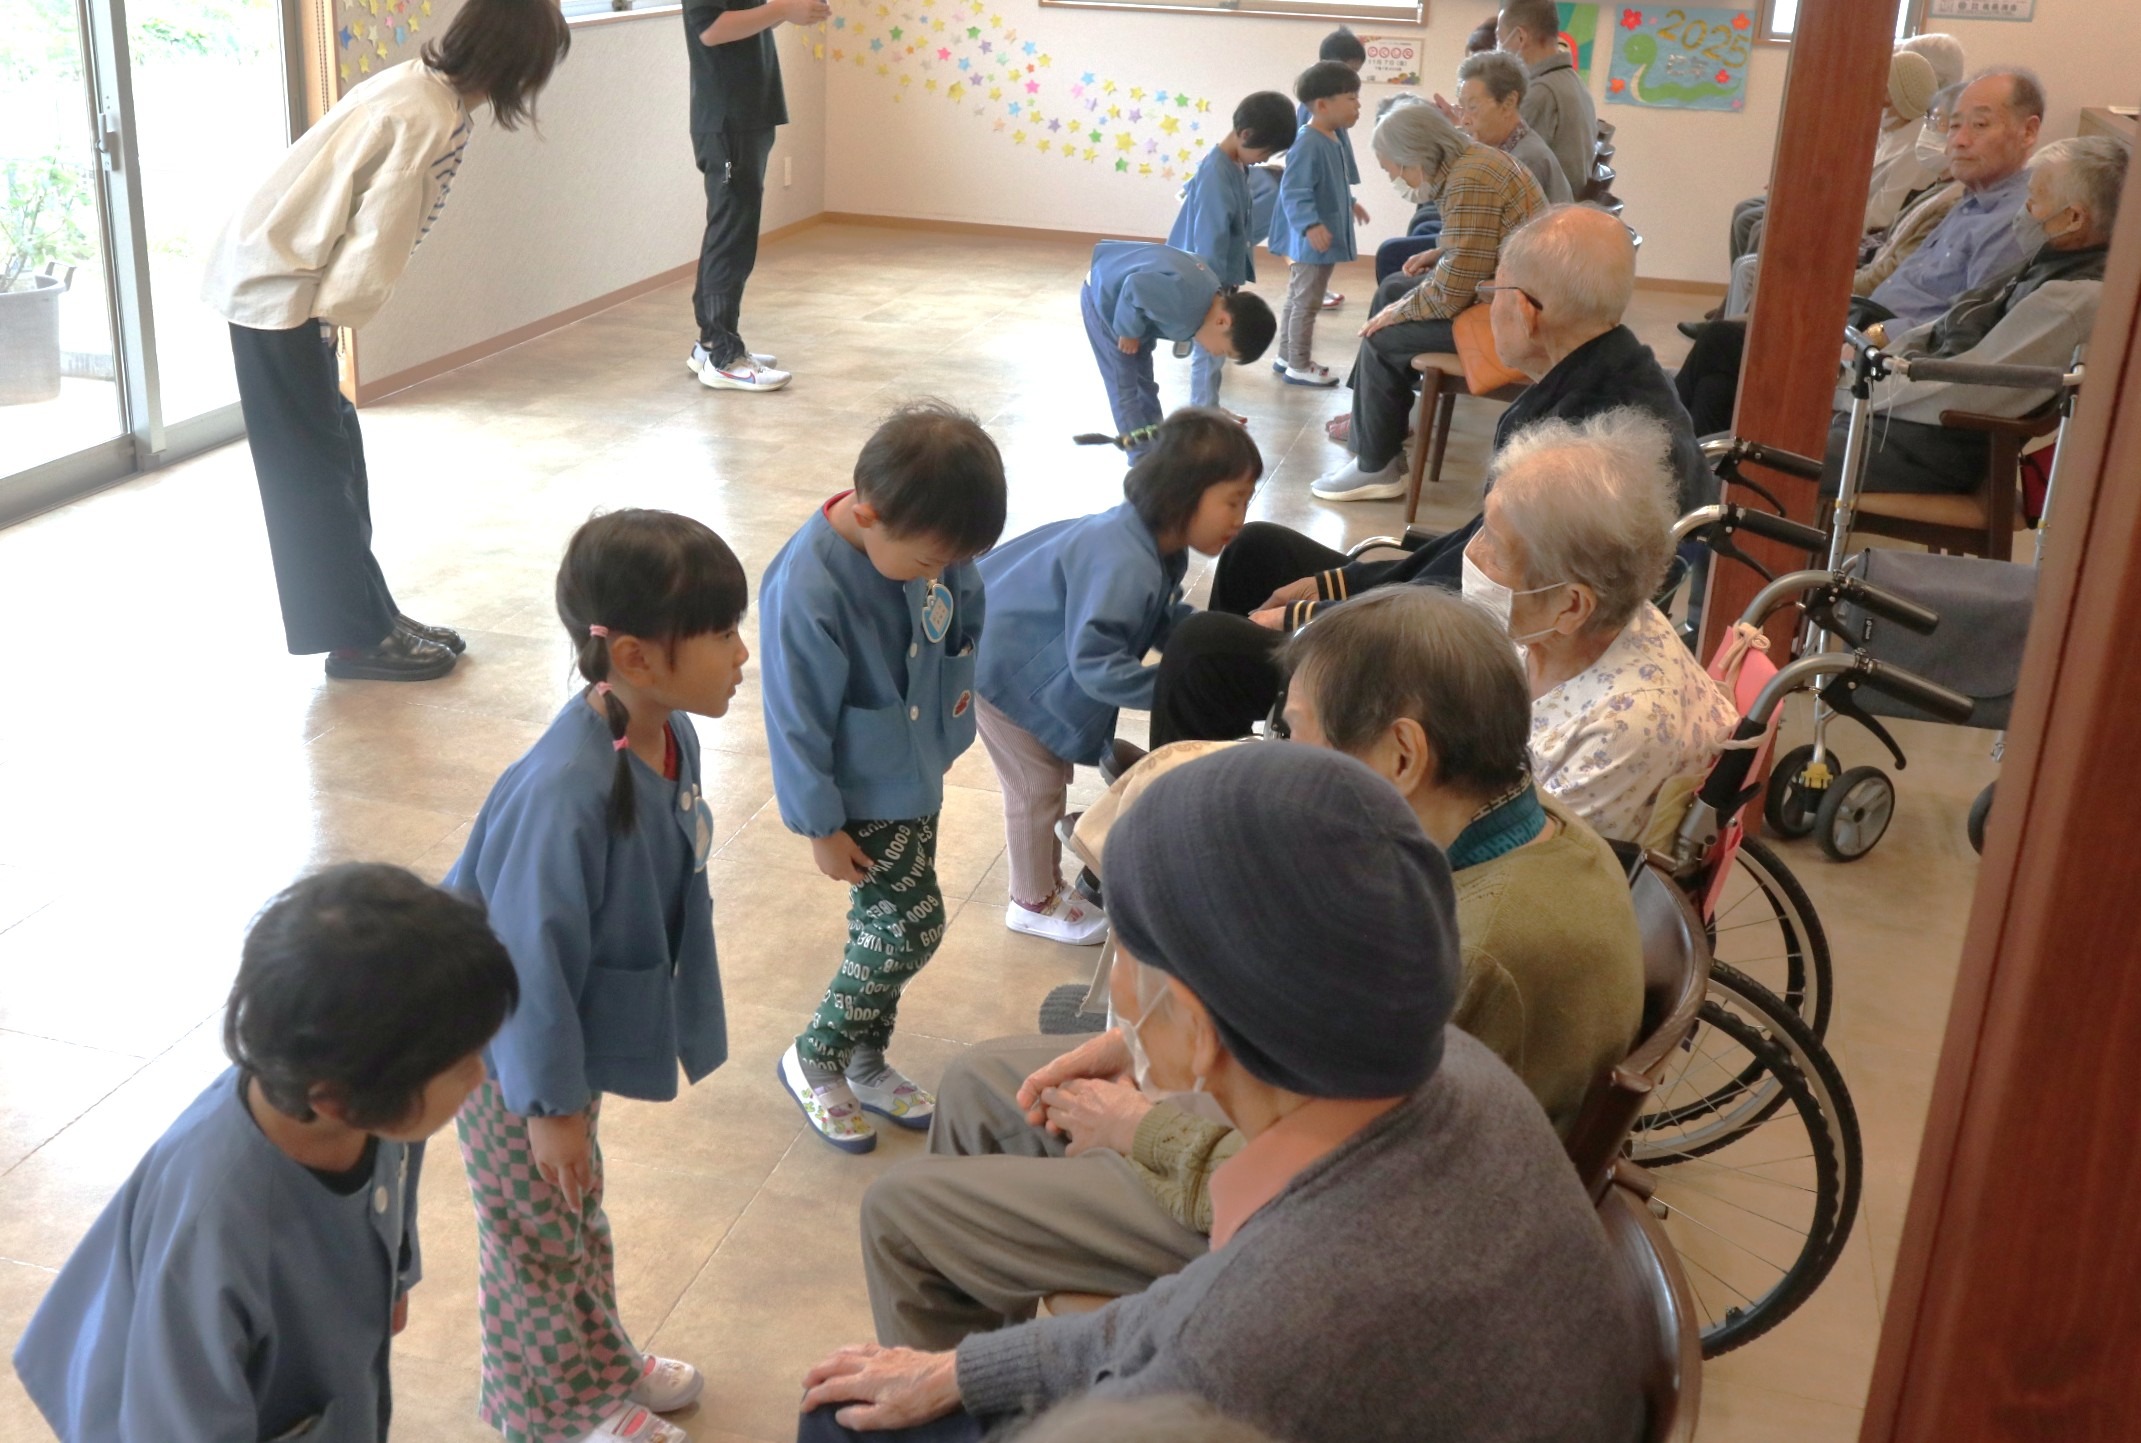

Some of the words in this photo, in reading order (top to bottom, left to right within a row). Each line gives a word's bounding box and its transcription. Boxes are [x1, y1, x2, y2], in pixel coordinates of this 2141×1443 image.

[1657, 9, 1750, 68] 2025
[884, 824, 911, 860] GOOD
[841, 959, 870, 982] GOOD
